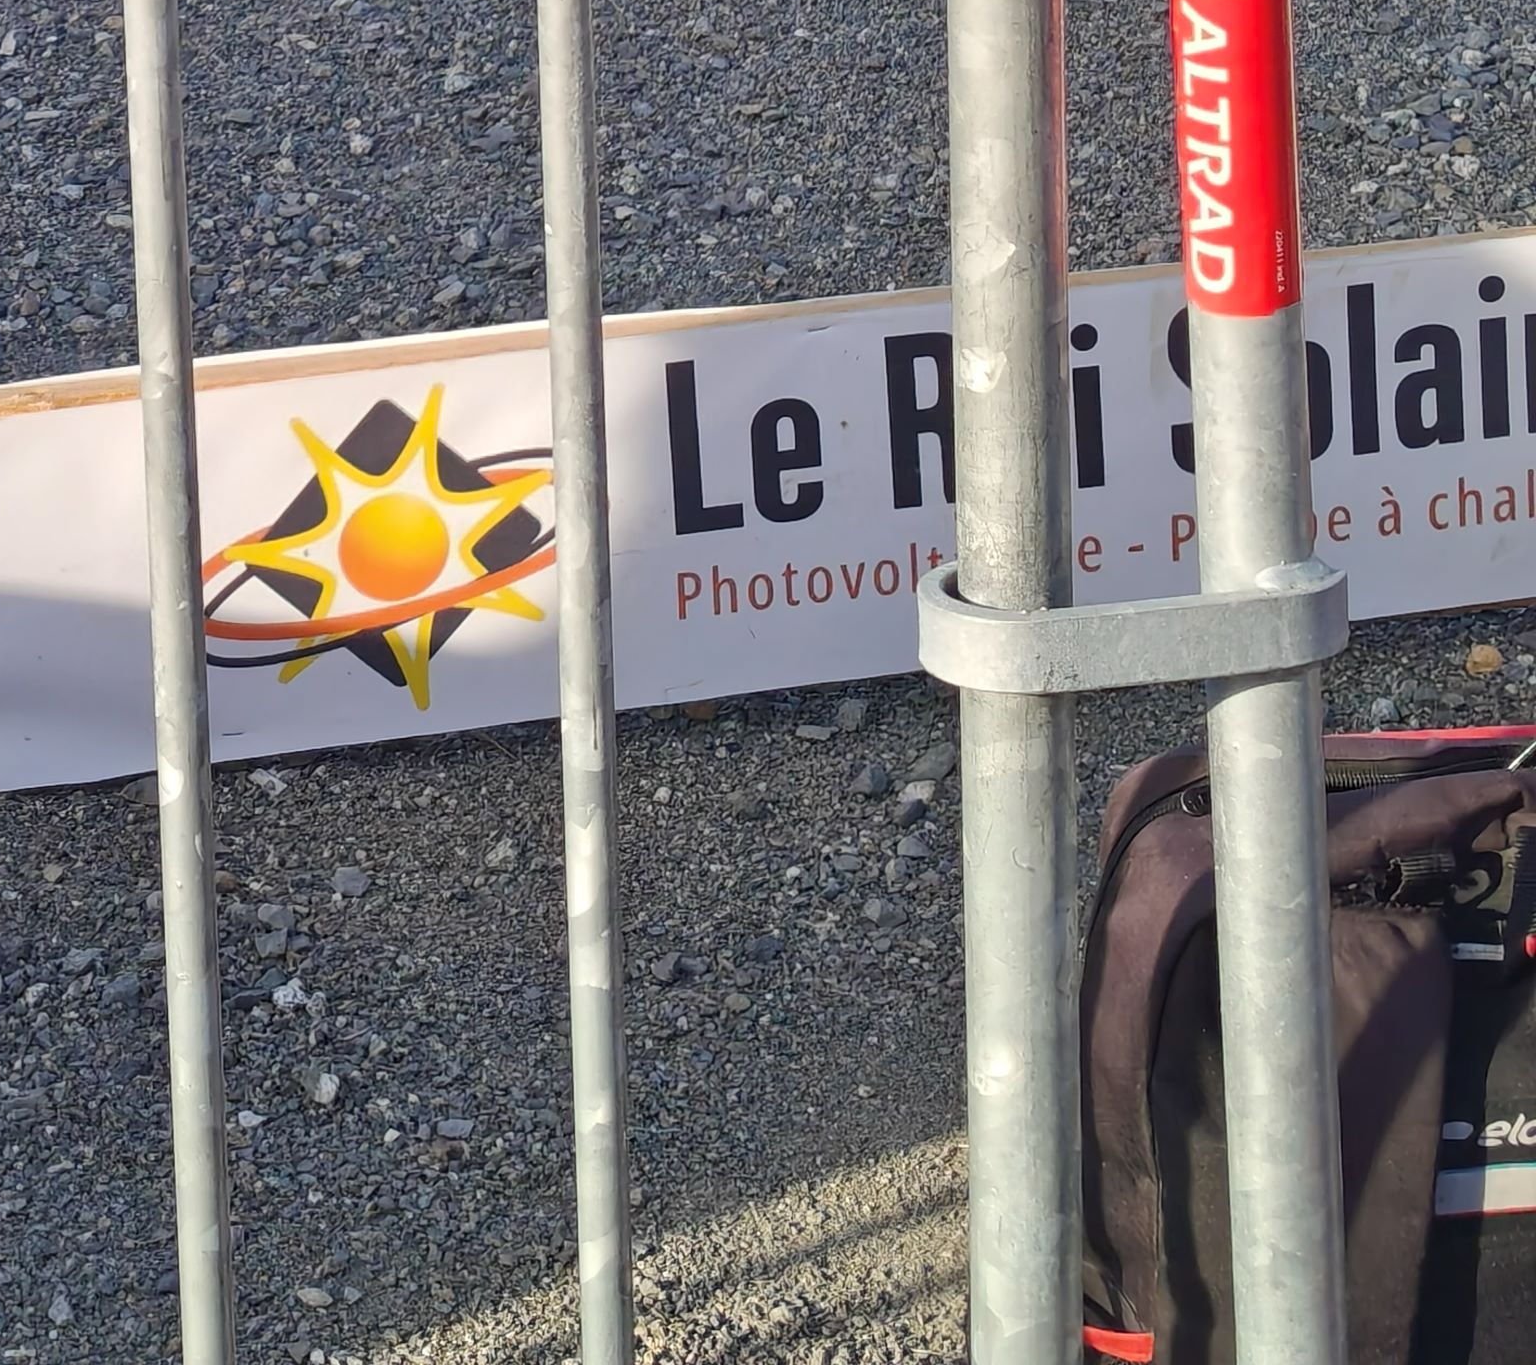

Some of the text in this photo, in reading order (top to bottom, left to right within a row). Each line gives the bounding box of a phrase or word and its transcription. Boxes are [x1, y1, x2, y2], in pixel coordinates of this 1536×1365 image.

[665, 358, 825, 536] Le
[884, 322, 1108, 510] Ri
[676, 533, 1103, 621] Photovolte
[1377, 485, 1402, 537] à
